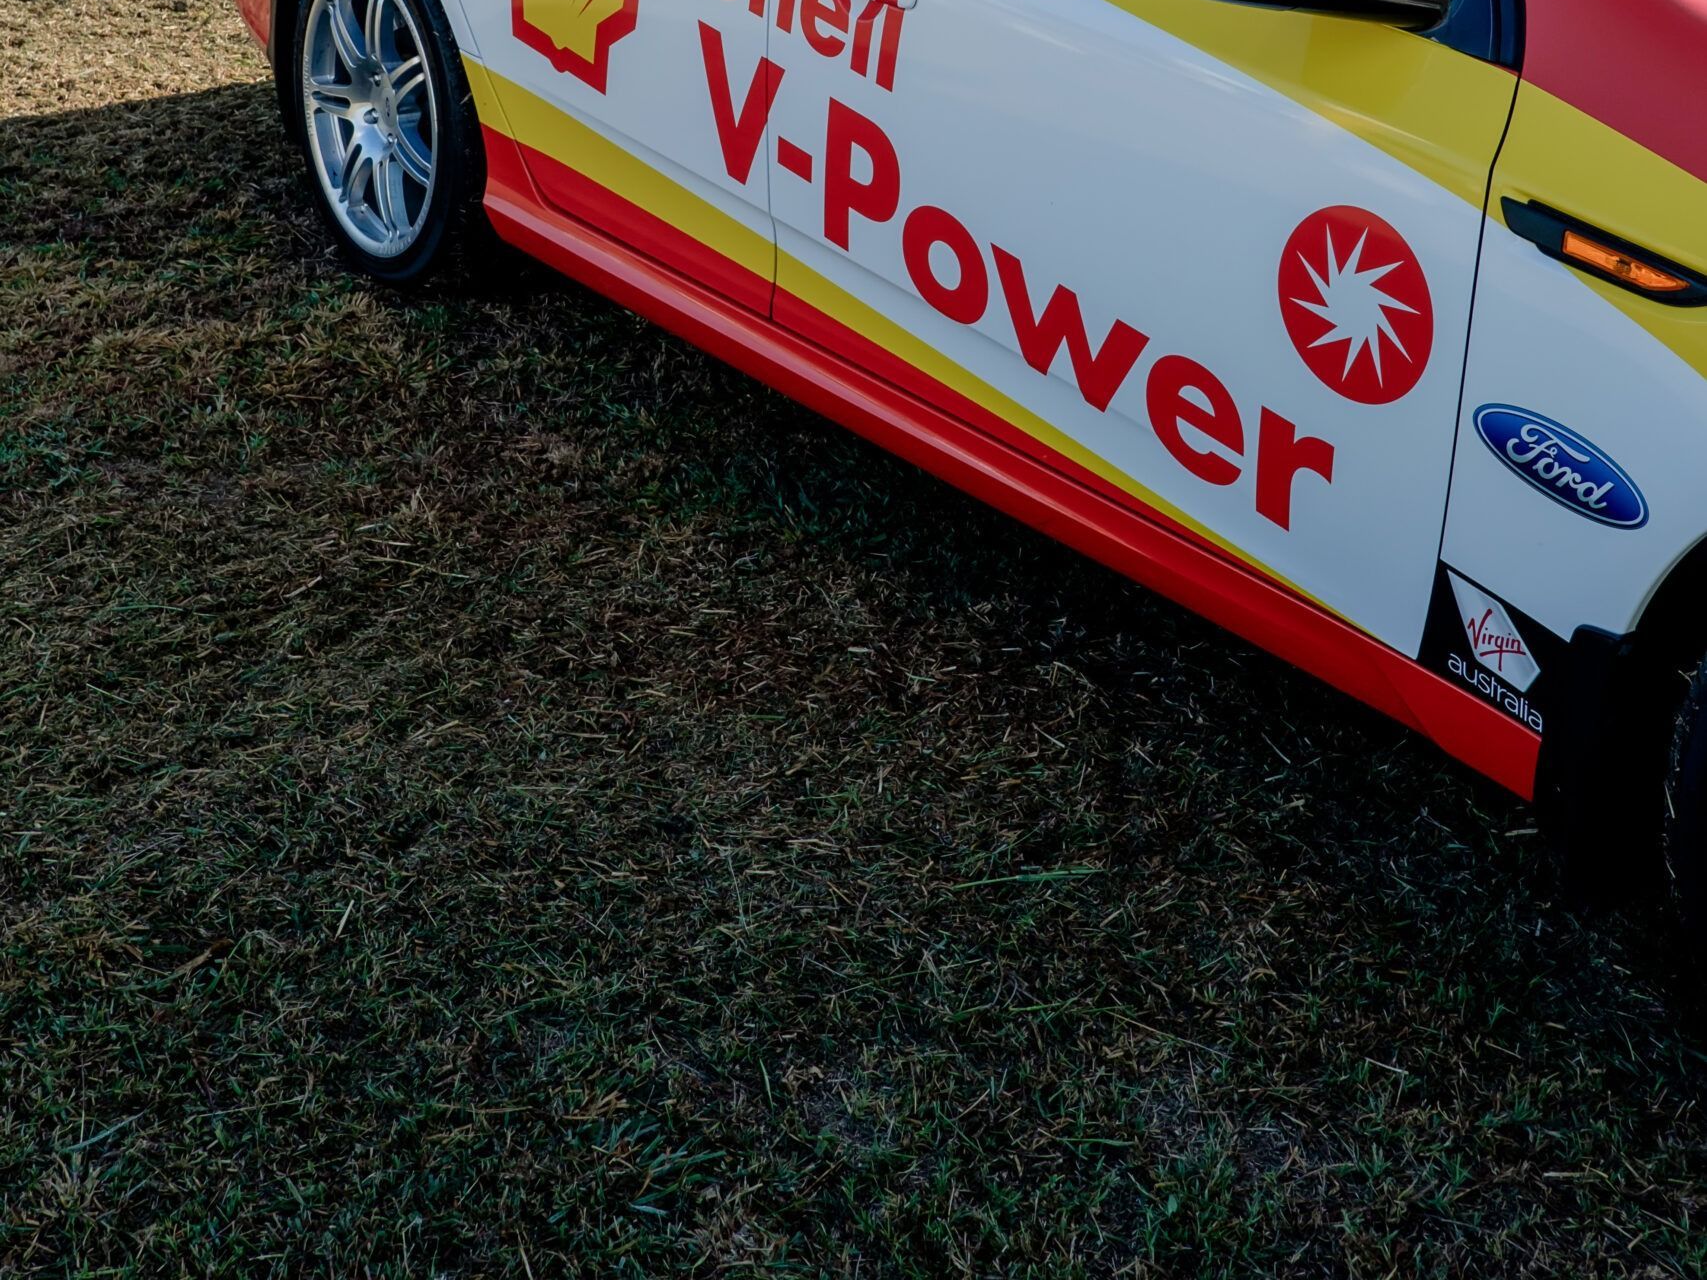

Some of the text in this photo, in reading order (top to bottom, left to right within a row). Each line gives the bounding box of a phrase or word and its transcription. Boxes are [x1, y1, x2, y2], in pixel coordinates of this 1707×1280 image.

[698, 19, 1335, 532] V-Power
[1506, 423, 1617, 510] Ford
[1467, 608, 1527, 673] Virgin
[1447, 652, 1544, 733] australia
